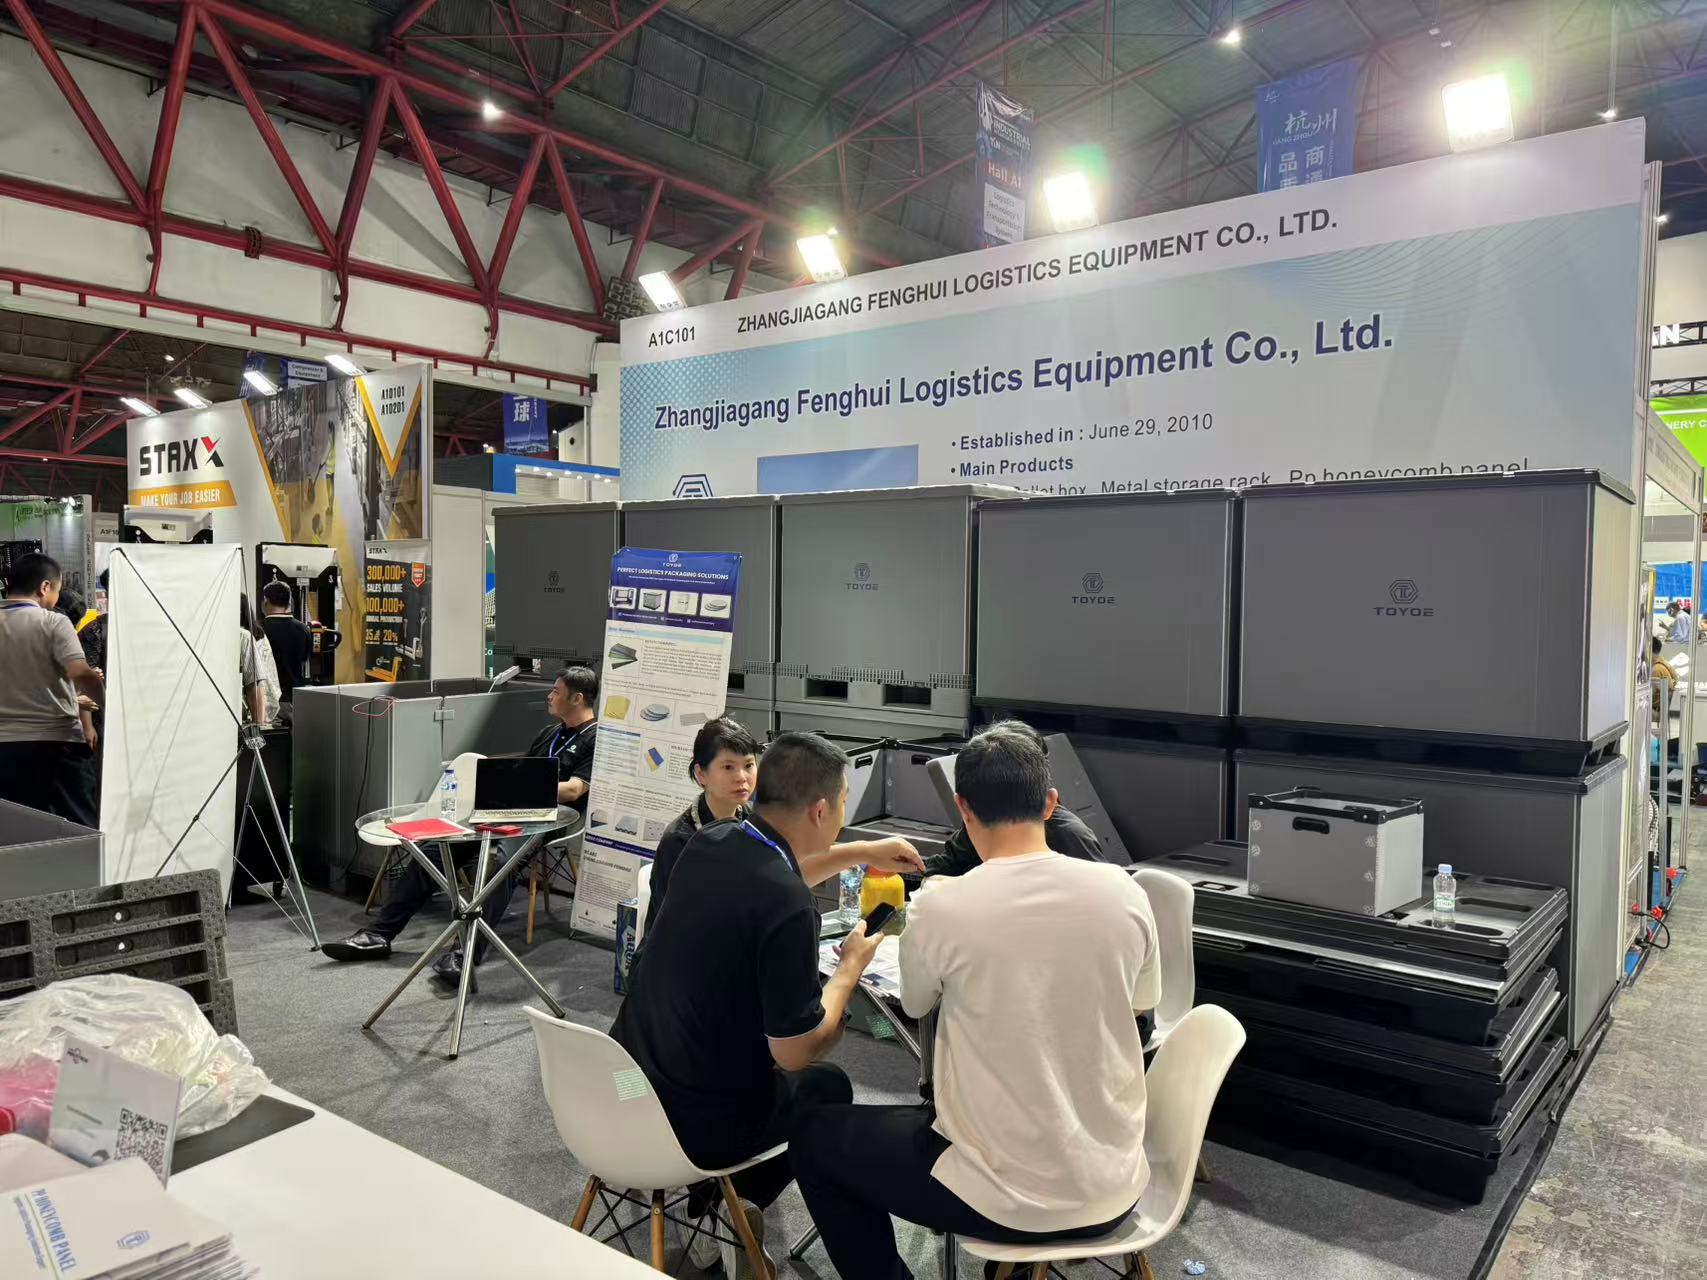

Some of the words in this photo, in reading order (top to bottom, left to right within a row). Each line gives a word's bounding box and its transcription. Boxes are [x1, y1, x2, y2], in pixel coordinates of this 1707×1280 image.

[1284, 107, 1337, 135] 杭州
[988, 160, 1008, 183] Hall
[738, 297, 862, 333] ZHANGJIAGANG
[868, 280, 947, 311] FENGHUI
[953, 258, 1061, 295] LOGISTICS
[1068, 230, 1209, 275] EQUIPMENT
[1216, 222, 1269, 248] CO.,
[1279, 208, 1337, 238] LTD.
[648, 326, 696, 347] A1C101
[655, 397, 789, 430] Zhangjiagang
[797, 379, 890, 416] Fenghui
[899, 366, 1023, 407] Logistics
[1033, 336, 1213, 392] Equipment
[1225, 331, 1299, 364] Co.,
[1315, 313, 1393, 355] Ltd.
[960, 428, 1053, 450] Established
[1058, 426, 1073, 442] in
[1088, 423, 1130, 440] June
[1134, 419, 1161, 438] 29,
[1167, 413, 1213, 433] 2010
[960, 462, 995, 477] Main
[1000, 457, 1074, 475] Products
[141, 494, 159, 507] MAKE
[161, 492, 178, 506] YOUR
[181, 490, 193, 504] JOB
[195, 488, 221, 503] EASIER
[367, 564, 407, 583] 300,000+
[617, 566, 638, 574] PERFECT
[638, 568, 664, 576] LOGISTICS
[664, 570, 697, 578] PACKAGING
[697, 572, 730, 580] SOLUTIONS
[366, 583, 381, 593] SALES
[382, 583, 403, 593] VOLUME
[366, 597, 405, 615] 100,000+
[1072, 596, 1115, 604] TOYOE
[1375, 607, 1434, 617] TOYOE
[36, 1195, 66, 1242] HONEYCOMB
[53, 1241, 77, 1273] PANEL
